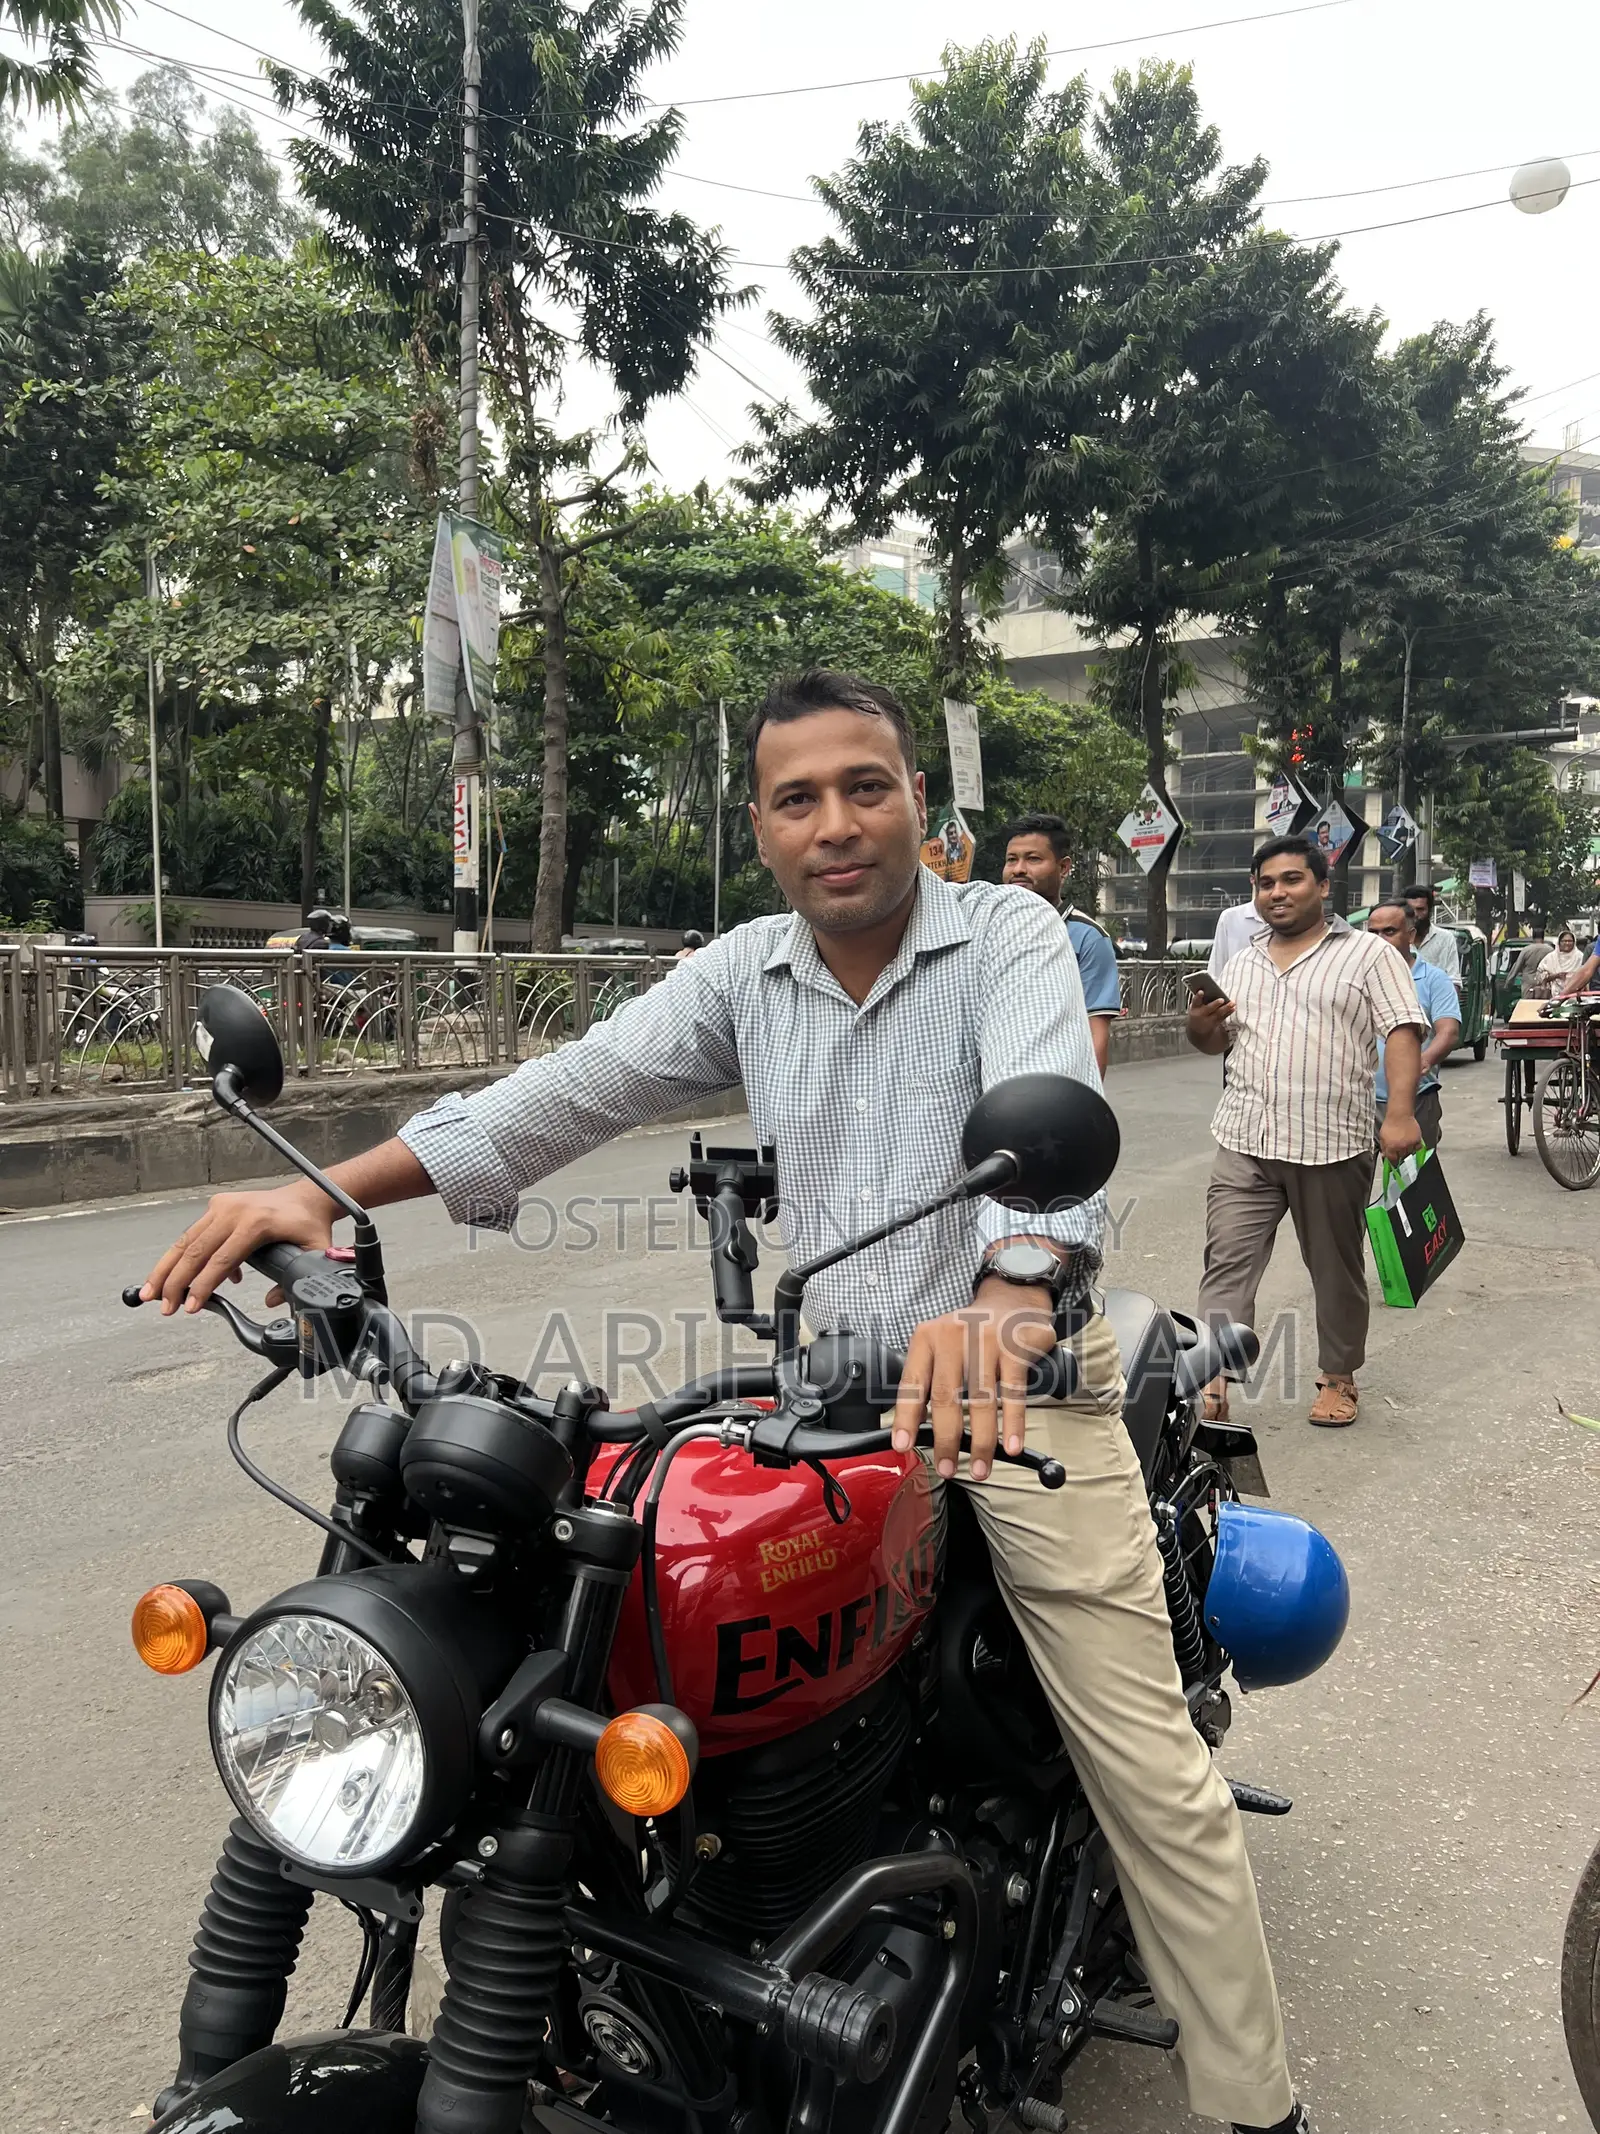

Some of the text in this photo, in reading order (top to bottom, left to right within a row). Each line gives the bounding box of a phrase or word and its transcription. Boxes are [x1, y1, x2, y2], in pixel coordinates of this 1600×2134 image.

[928, 845, 943, 857] 134
[1424, 1215, 1448, 1265] EASY
[758, 1529, 824, 1565] ROYAL
[759, 1548, 837, 1593] ENFIELD
